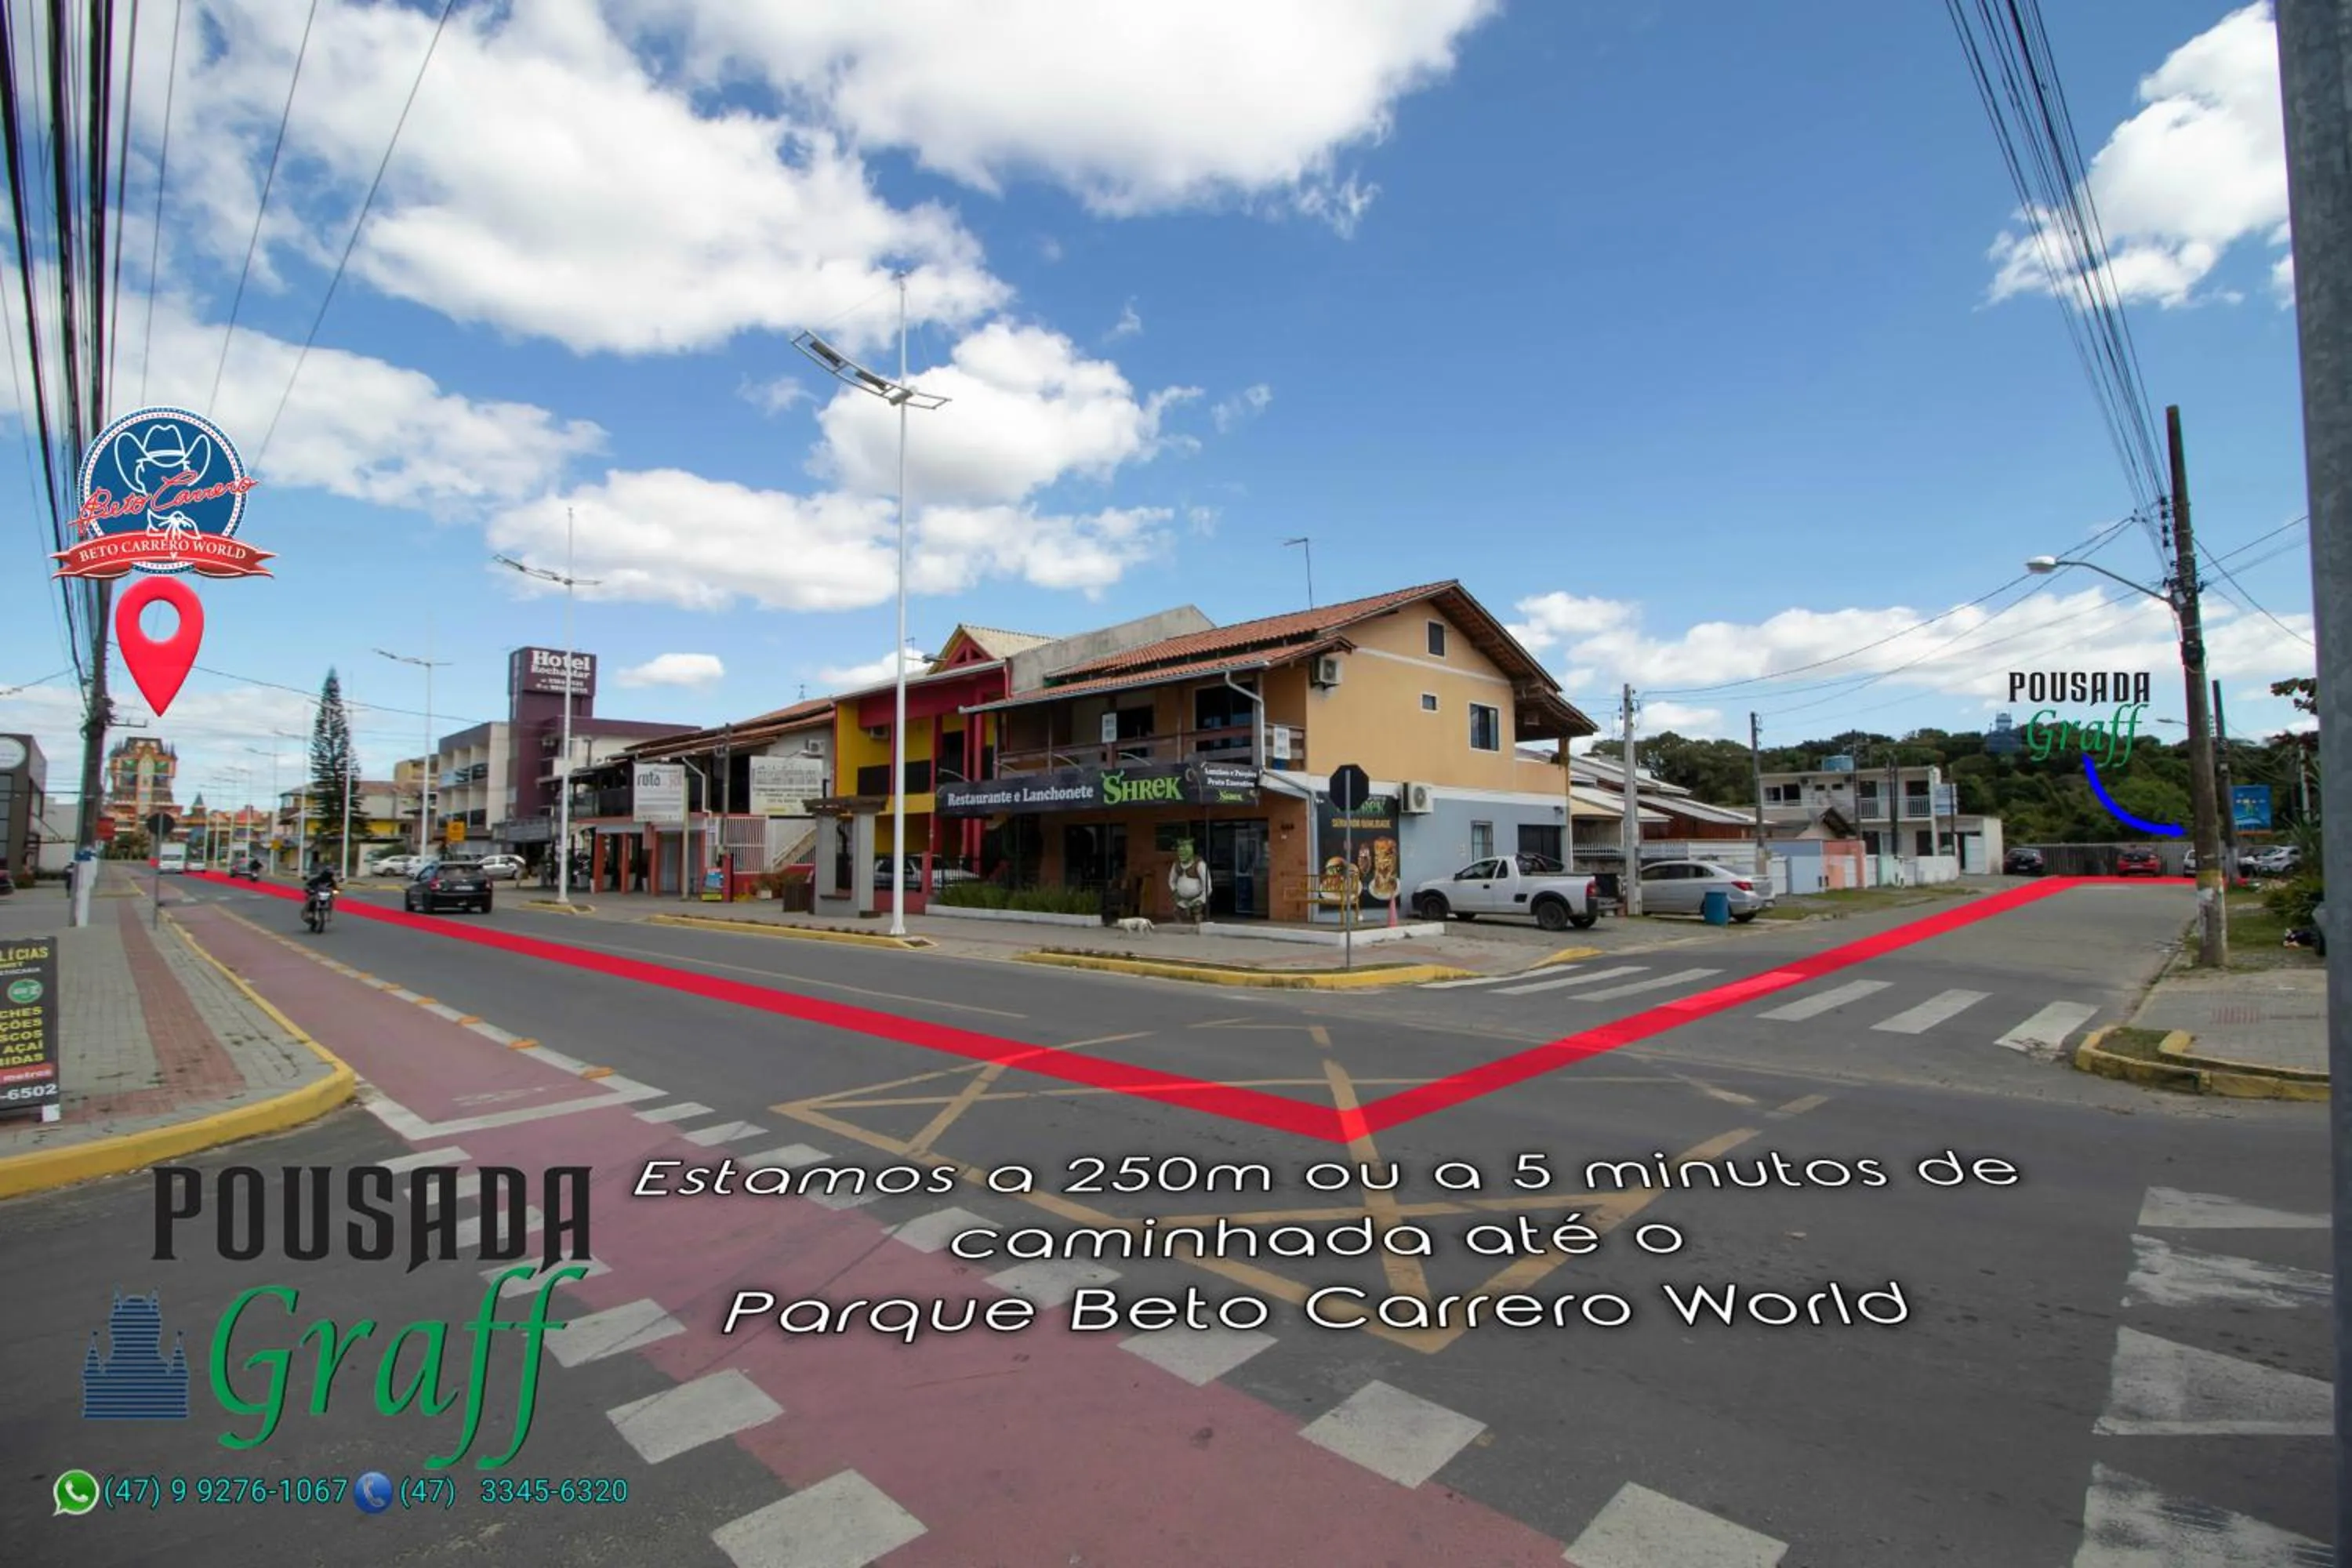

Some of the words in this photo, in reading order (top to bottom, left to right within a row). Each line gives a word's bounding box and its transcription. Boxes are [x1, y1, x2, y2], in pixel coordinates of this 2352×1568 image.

[532, 651, 590, 671] Hotel
[948, 786, 1012, 806] Restaurante
[1014, 792, 1021, 803] e
[1022, 786, 1094, 801] Lanchonete
